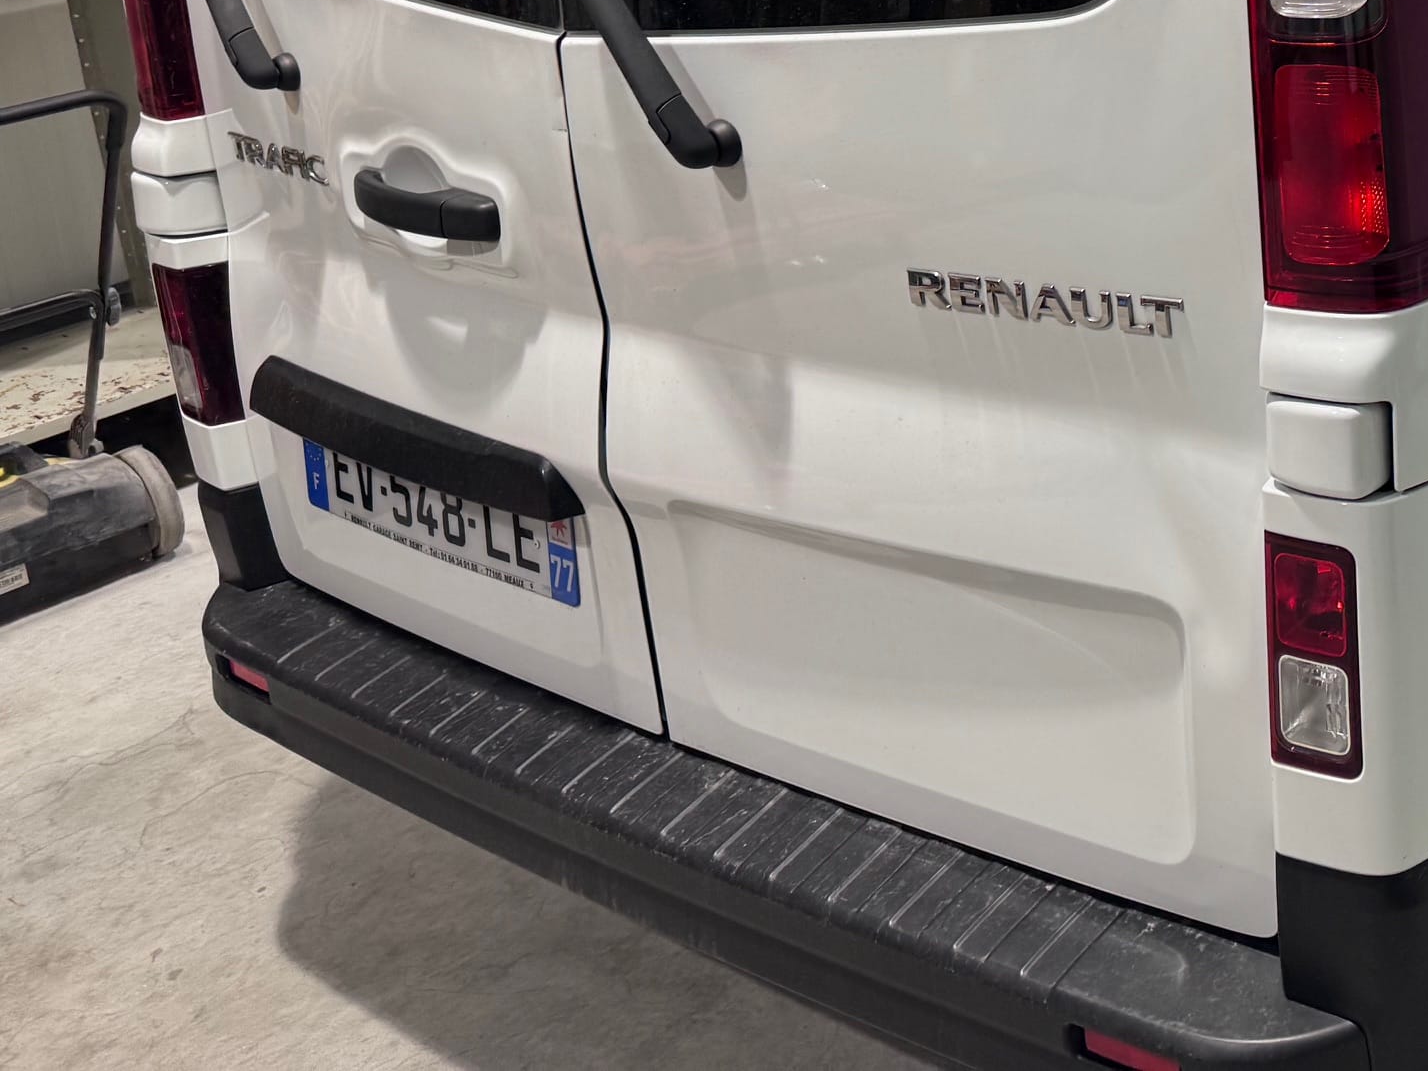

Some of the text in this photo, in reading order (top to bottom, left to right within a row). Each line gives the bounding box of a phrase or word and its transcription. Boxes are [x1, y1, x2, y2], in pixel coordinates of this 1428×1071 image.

[227, 131, 329, 186] TRAFIC
[906, 267, 1184, 337] RENAULT
[313, 471, 320, 490] F
[551, 554, 574, 593] 77
